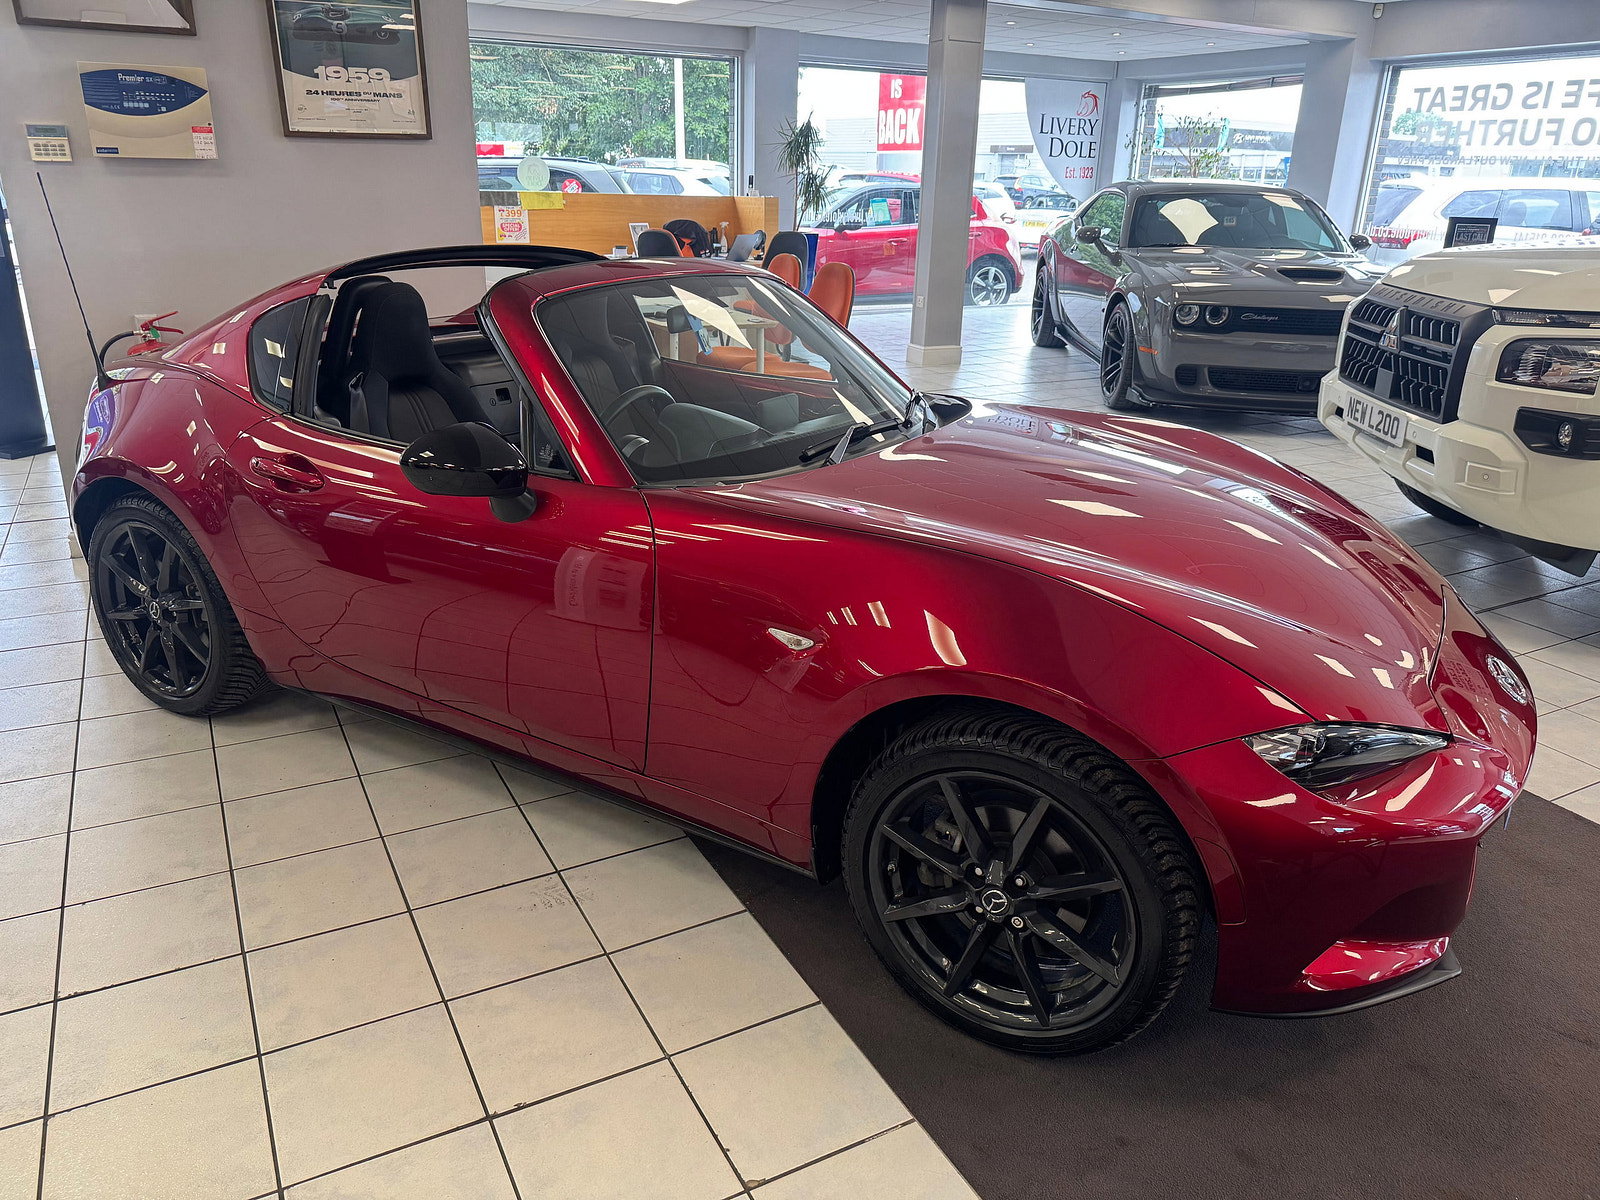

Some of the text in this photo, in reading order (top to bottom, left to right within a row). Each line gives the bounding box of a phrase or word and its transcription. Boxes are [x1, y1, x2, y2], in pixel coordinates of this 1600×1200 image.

[335, 23, 343, 33] 5
[117, 72, 145, 82] Premier
[313, 65, 391, 84] 1959
[320, 89, 363, 97] HEURES
[890, 78, 903, 99] IS
[878, 107, 922, 145] BACK
[1039, 112, 1099, 136] LIVERY
[1048, 136, 1097, 159] DOLE
[1064, 166, 1094, 179] Est. 1923
[1455, 232, 1472, 241] LAST
[1375, 287, 1467, 314] MITSUBISHI
[1240, 312, 1280, 322] Challenger
[1346, 396, 1401, 440] NEW L200
